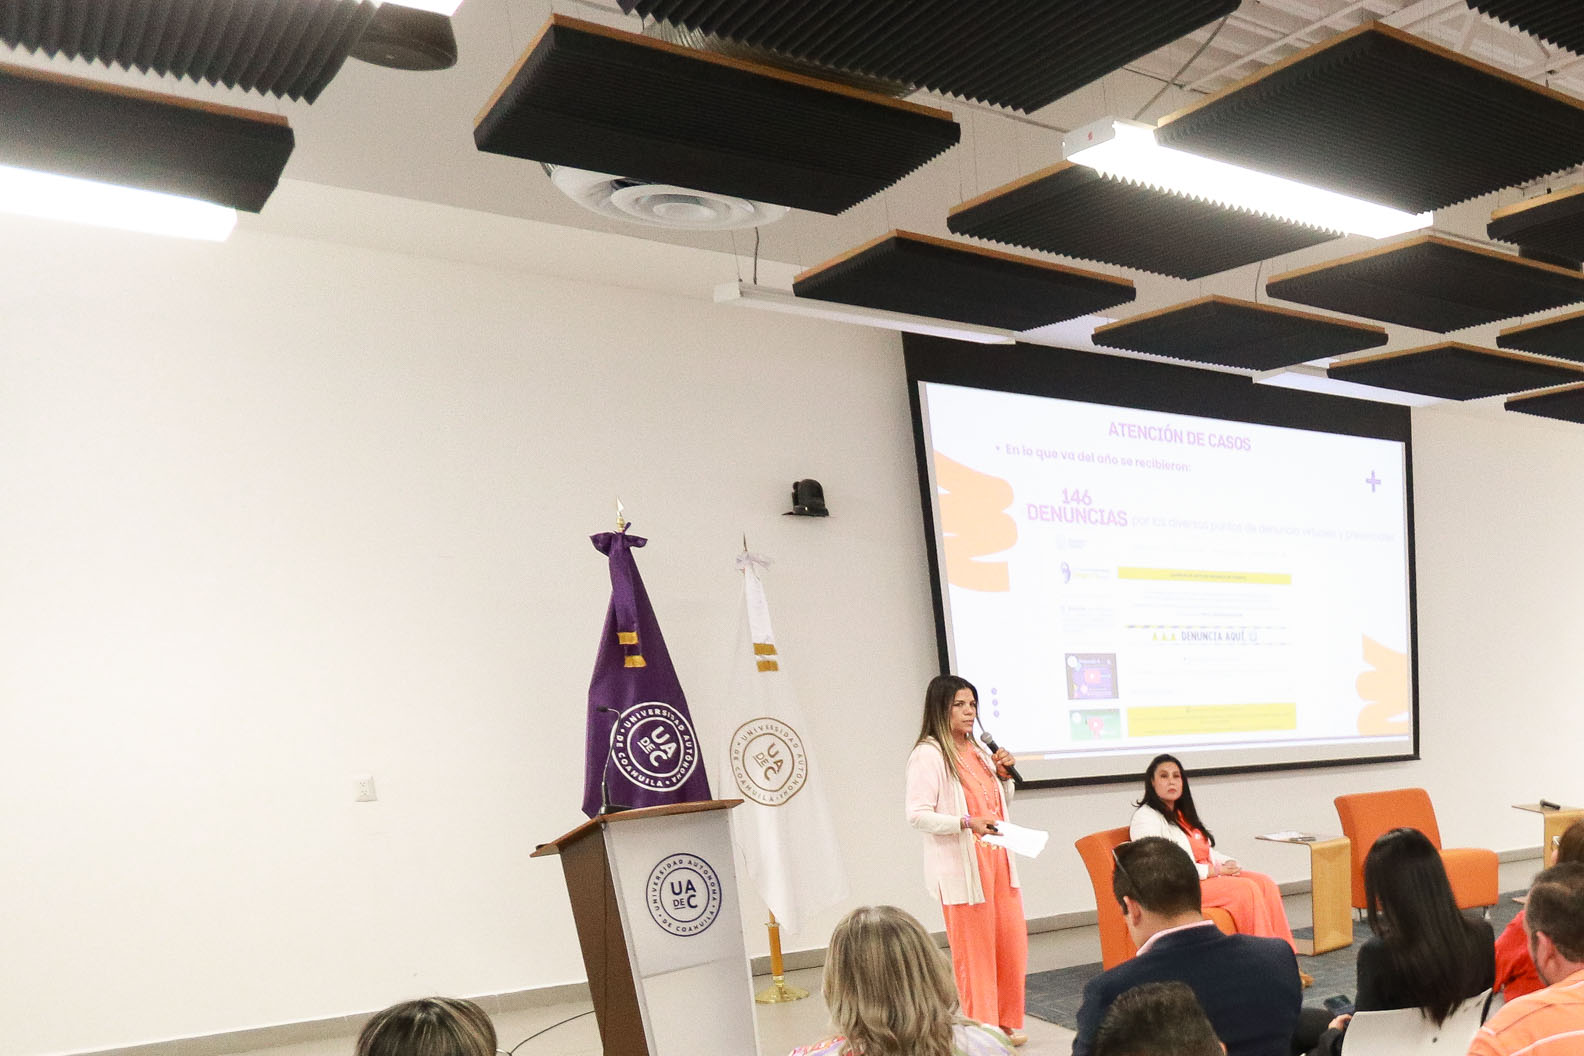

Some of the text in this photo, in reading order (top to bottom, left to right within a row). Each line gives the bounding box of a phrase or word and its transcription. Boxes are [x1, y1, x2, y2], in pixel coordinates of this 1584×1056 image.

[1108, 422, 1252, 451] ATENCIÓN DE CASOS
[1005, 443, 1191, 473] En lo que va del año se recibieron:
[1062, 487, 1092, 506] 146
[1026, 503, 1128, 527] DENUNCIAS
[1181, 629, 1245, 642] DENUNCIA AQUÍ
[623, 708, 685, 731] UNIVERSIDAD
[640, 737, 656, 753] DE
[651, 725, 677, 758] UA
[616, 735, 664, 787] DE COAHUILA
[755, 751, 769, 767] DE
[735, 766, 774, 802] COAHUILA
[651, 859, 683, 911] UNIVERSIDAD
[670, 879, 697, 896] UA
[673, 894, 698, 908] DE C
[662, 910, 715, 932] DE COAHUILA
